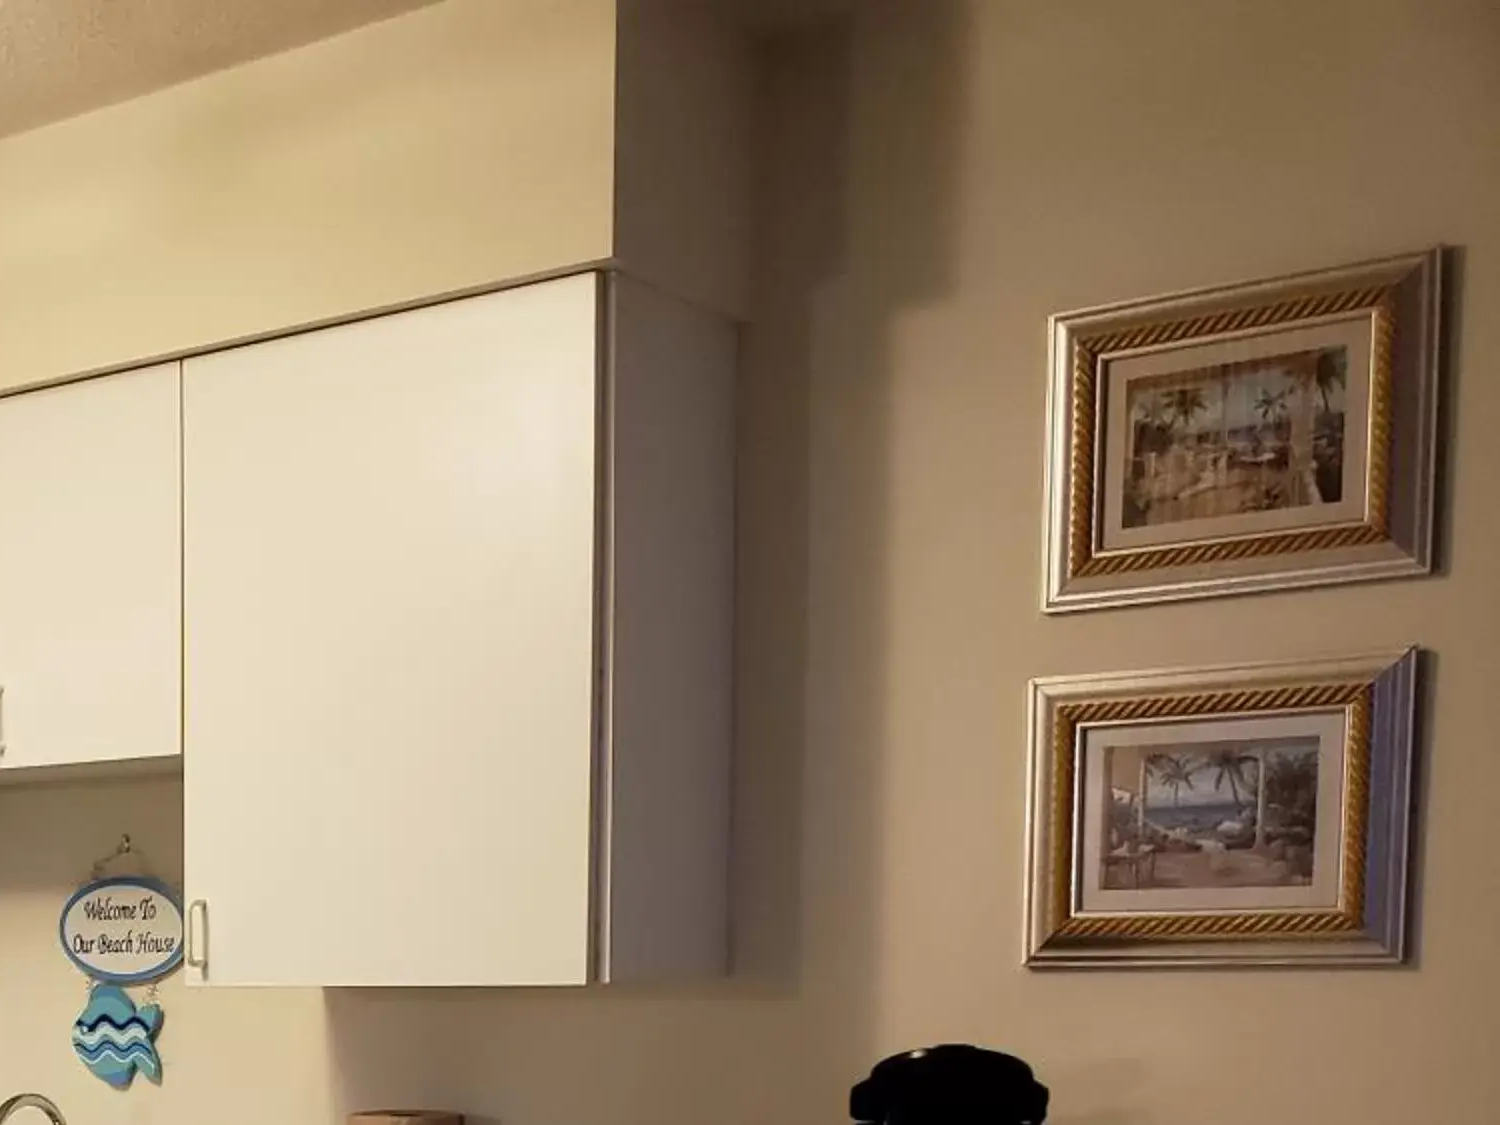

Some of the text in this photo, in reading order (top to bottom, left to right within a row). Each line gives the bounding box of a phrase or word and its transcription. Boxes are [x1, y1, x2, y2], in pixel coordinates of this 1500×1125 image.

[83, 896, 156, 921] Welcome To
[73, 929, 175, 955] Our Beach House
